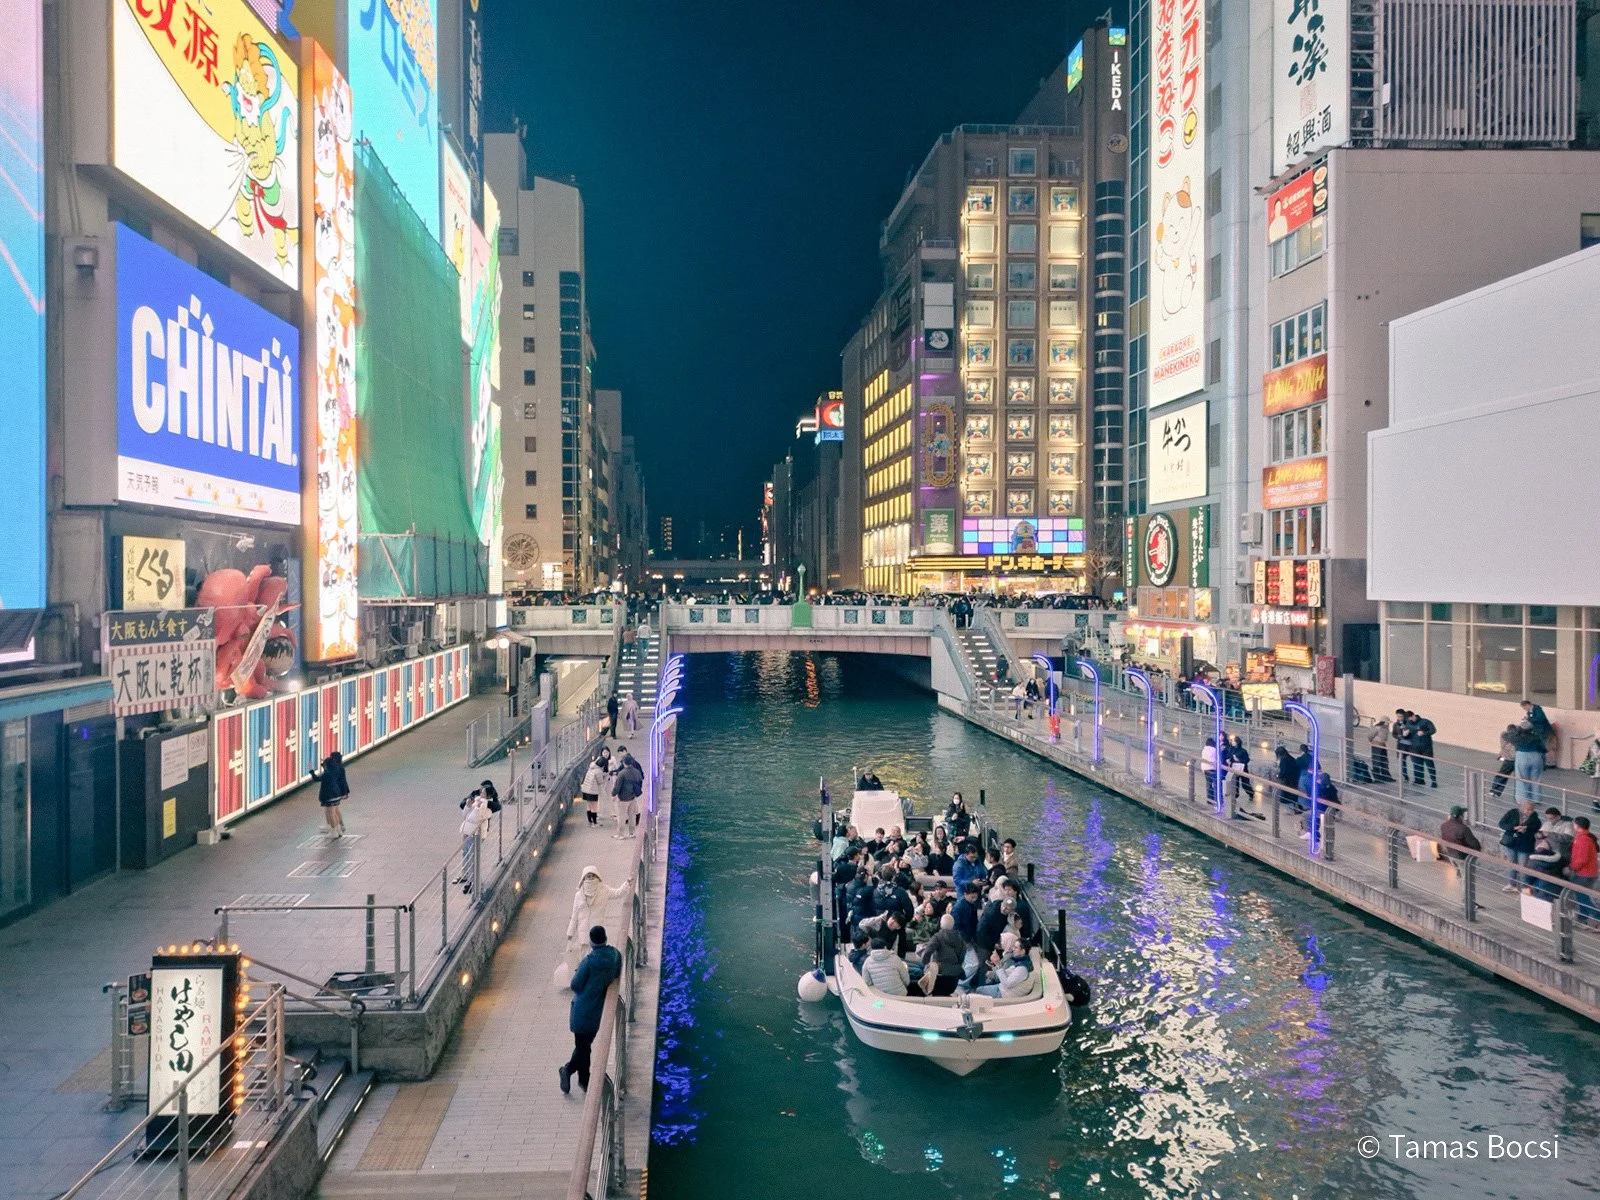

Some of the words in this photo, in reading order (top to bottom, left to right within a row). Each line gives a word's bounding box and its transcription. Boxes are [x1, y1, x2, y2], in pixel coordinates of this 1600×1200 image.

[1111, 51, 1122, 111] IKEDA
[1287, 104, 1331, 158] 紹興酒
[1153, 350, 1200, 380] MANEKINEKO
[1162, 417, 1191, 456] 牛かつ
[930, 514, 948, 533] 薬
[136, 547, 174, 600] くくる
[1309, 562, 1320, 606] 串かつ
[117, 652, 201, 704] 大阪に乾杯
[155, 987, 164, 1072] HAYASHIDA
[169, 978, 194, 1073] はやし田
